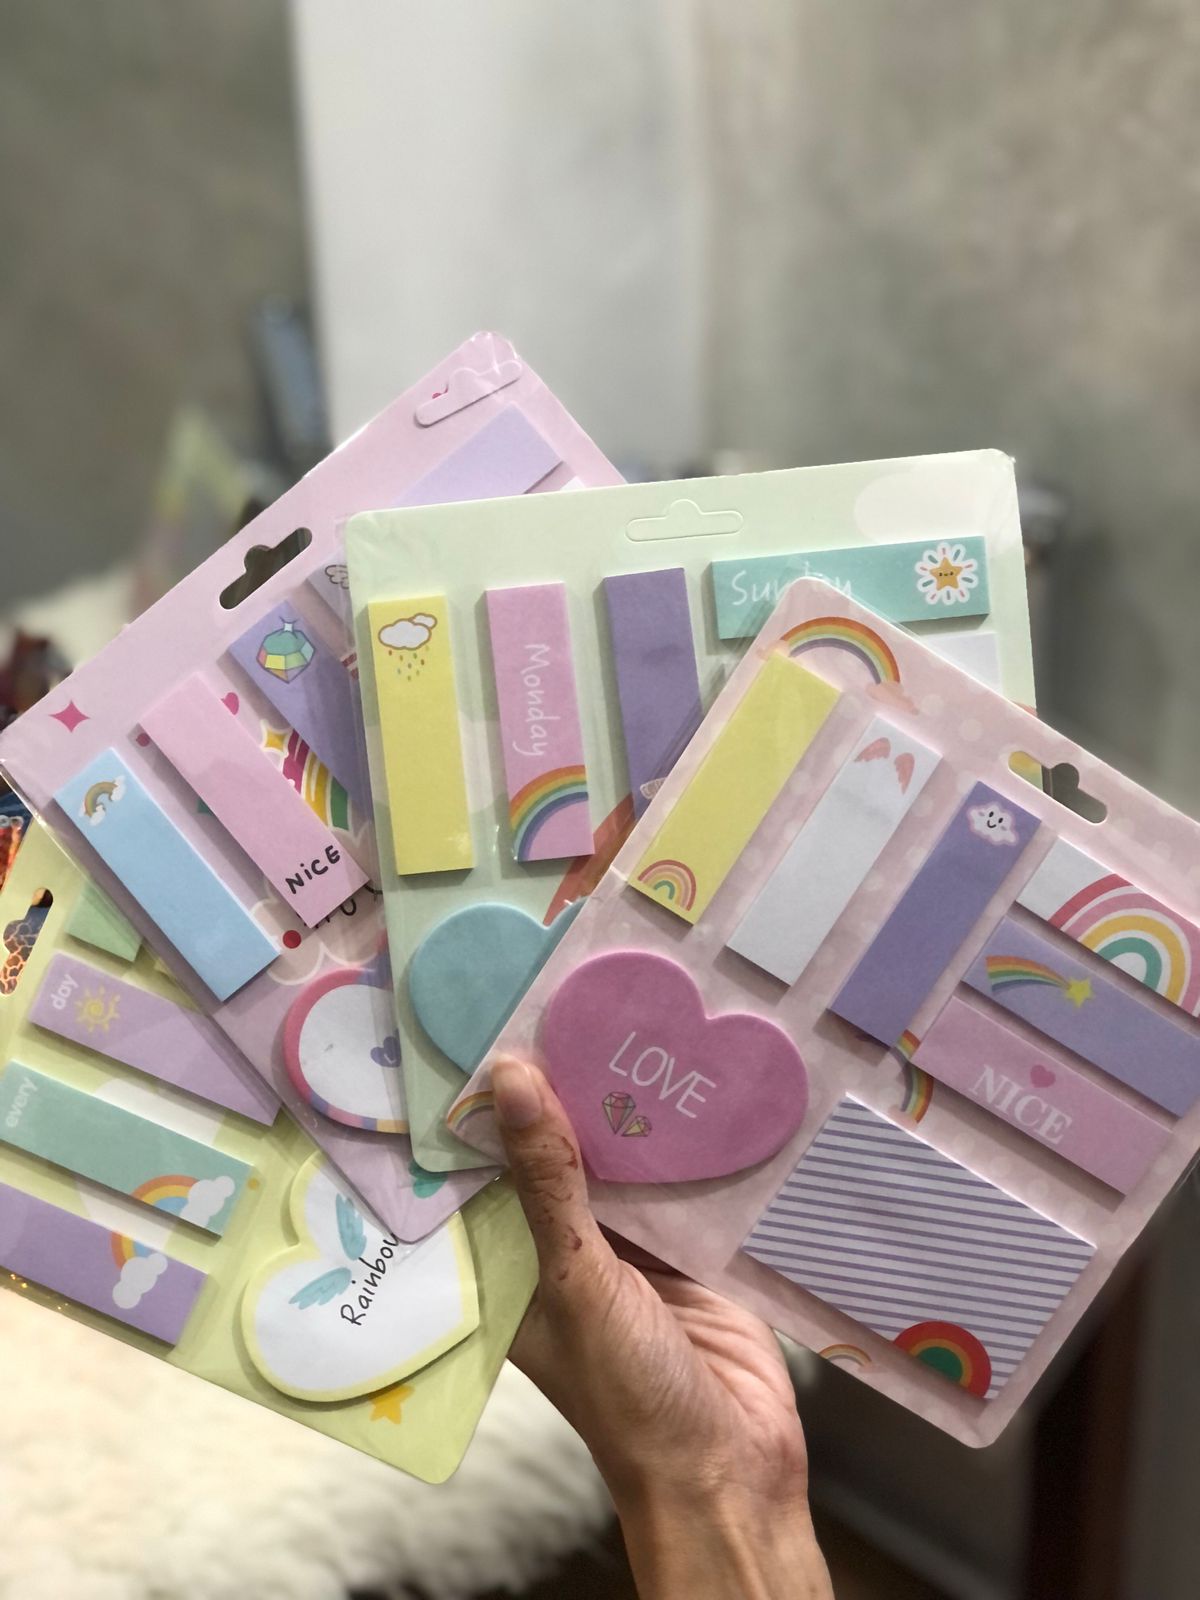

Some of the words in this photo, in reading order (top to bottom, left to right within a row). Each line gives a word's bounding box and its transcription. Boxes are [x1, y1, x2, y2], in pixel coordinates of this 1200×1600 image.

[512, 643, 560, 756] Monday
[50, 973, 79, 1010] day
[5, 1076, 38, 1128] every
[608, 1031, 717, 1119] LOVE
[967, 1063, 1073, 1145] NICE
